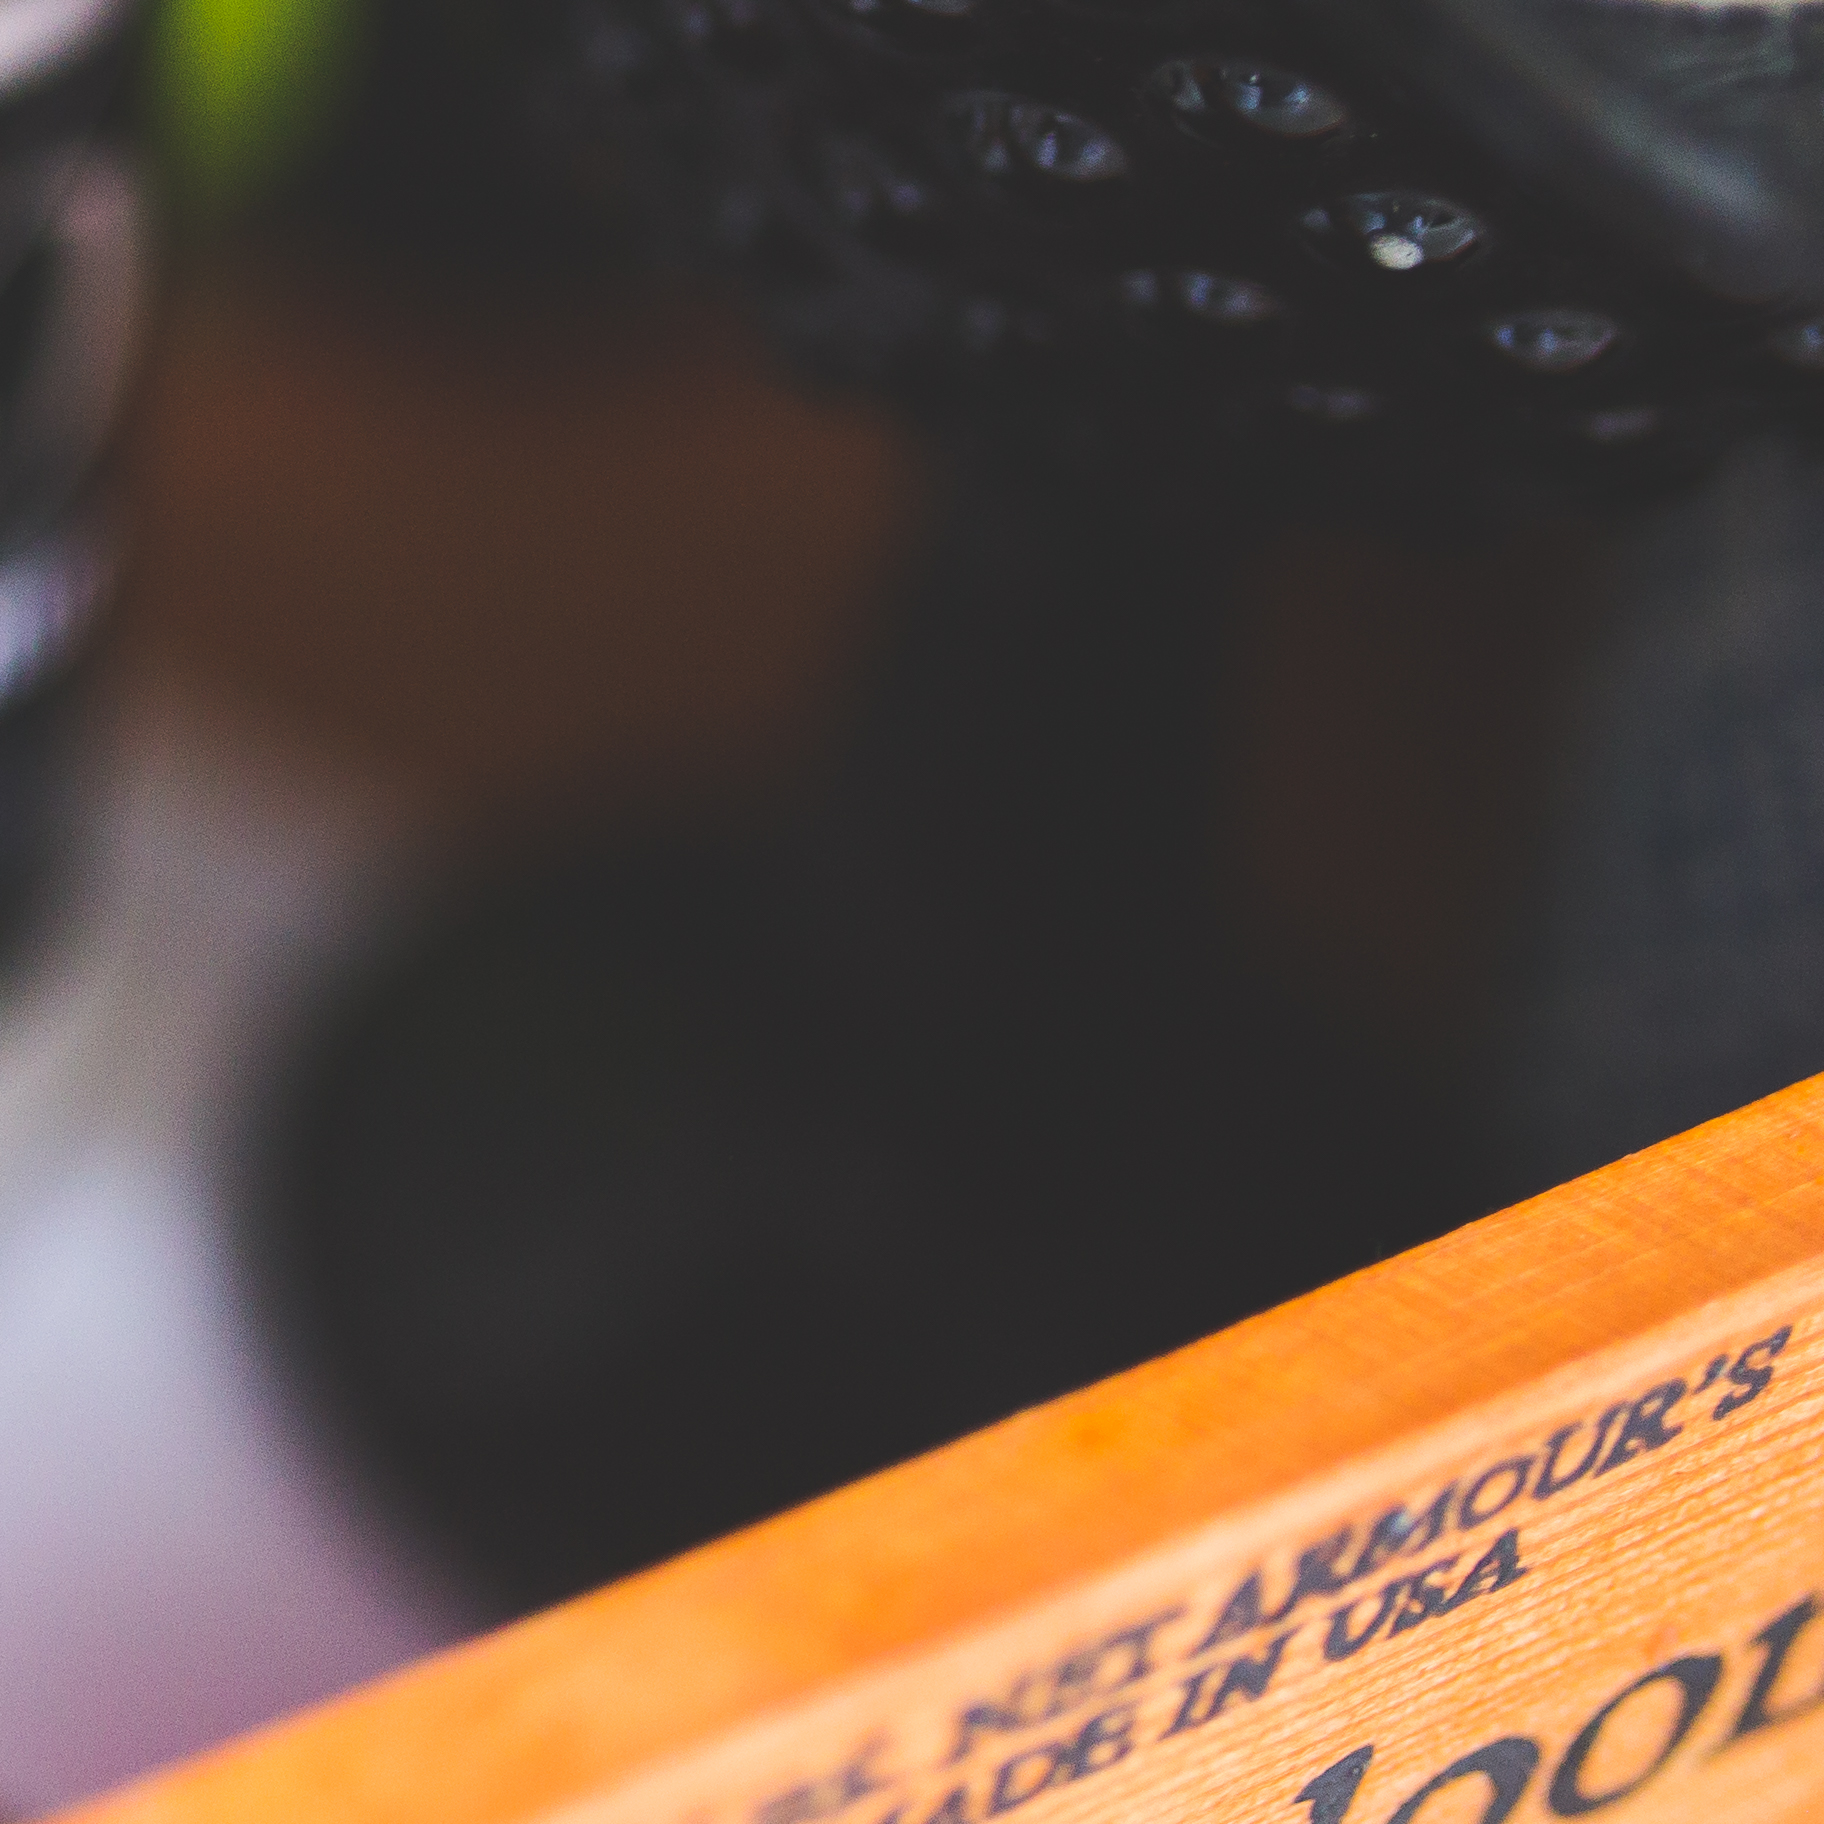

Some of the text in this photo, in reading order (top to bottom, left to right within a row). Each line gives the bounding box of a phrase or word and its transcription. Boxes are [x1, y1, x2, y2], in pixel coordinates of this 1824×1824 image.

[1187, 1325, 1793, 1659] ARMOUR'S
[1157, 1623, 1302, 1742] IN
[1323, 1526, 1529, 1662] USA
